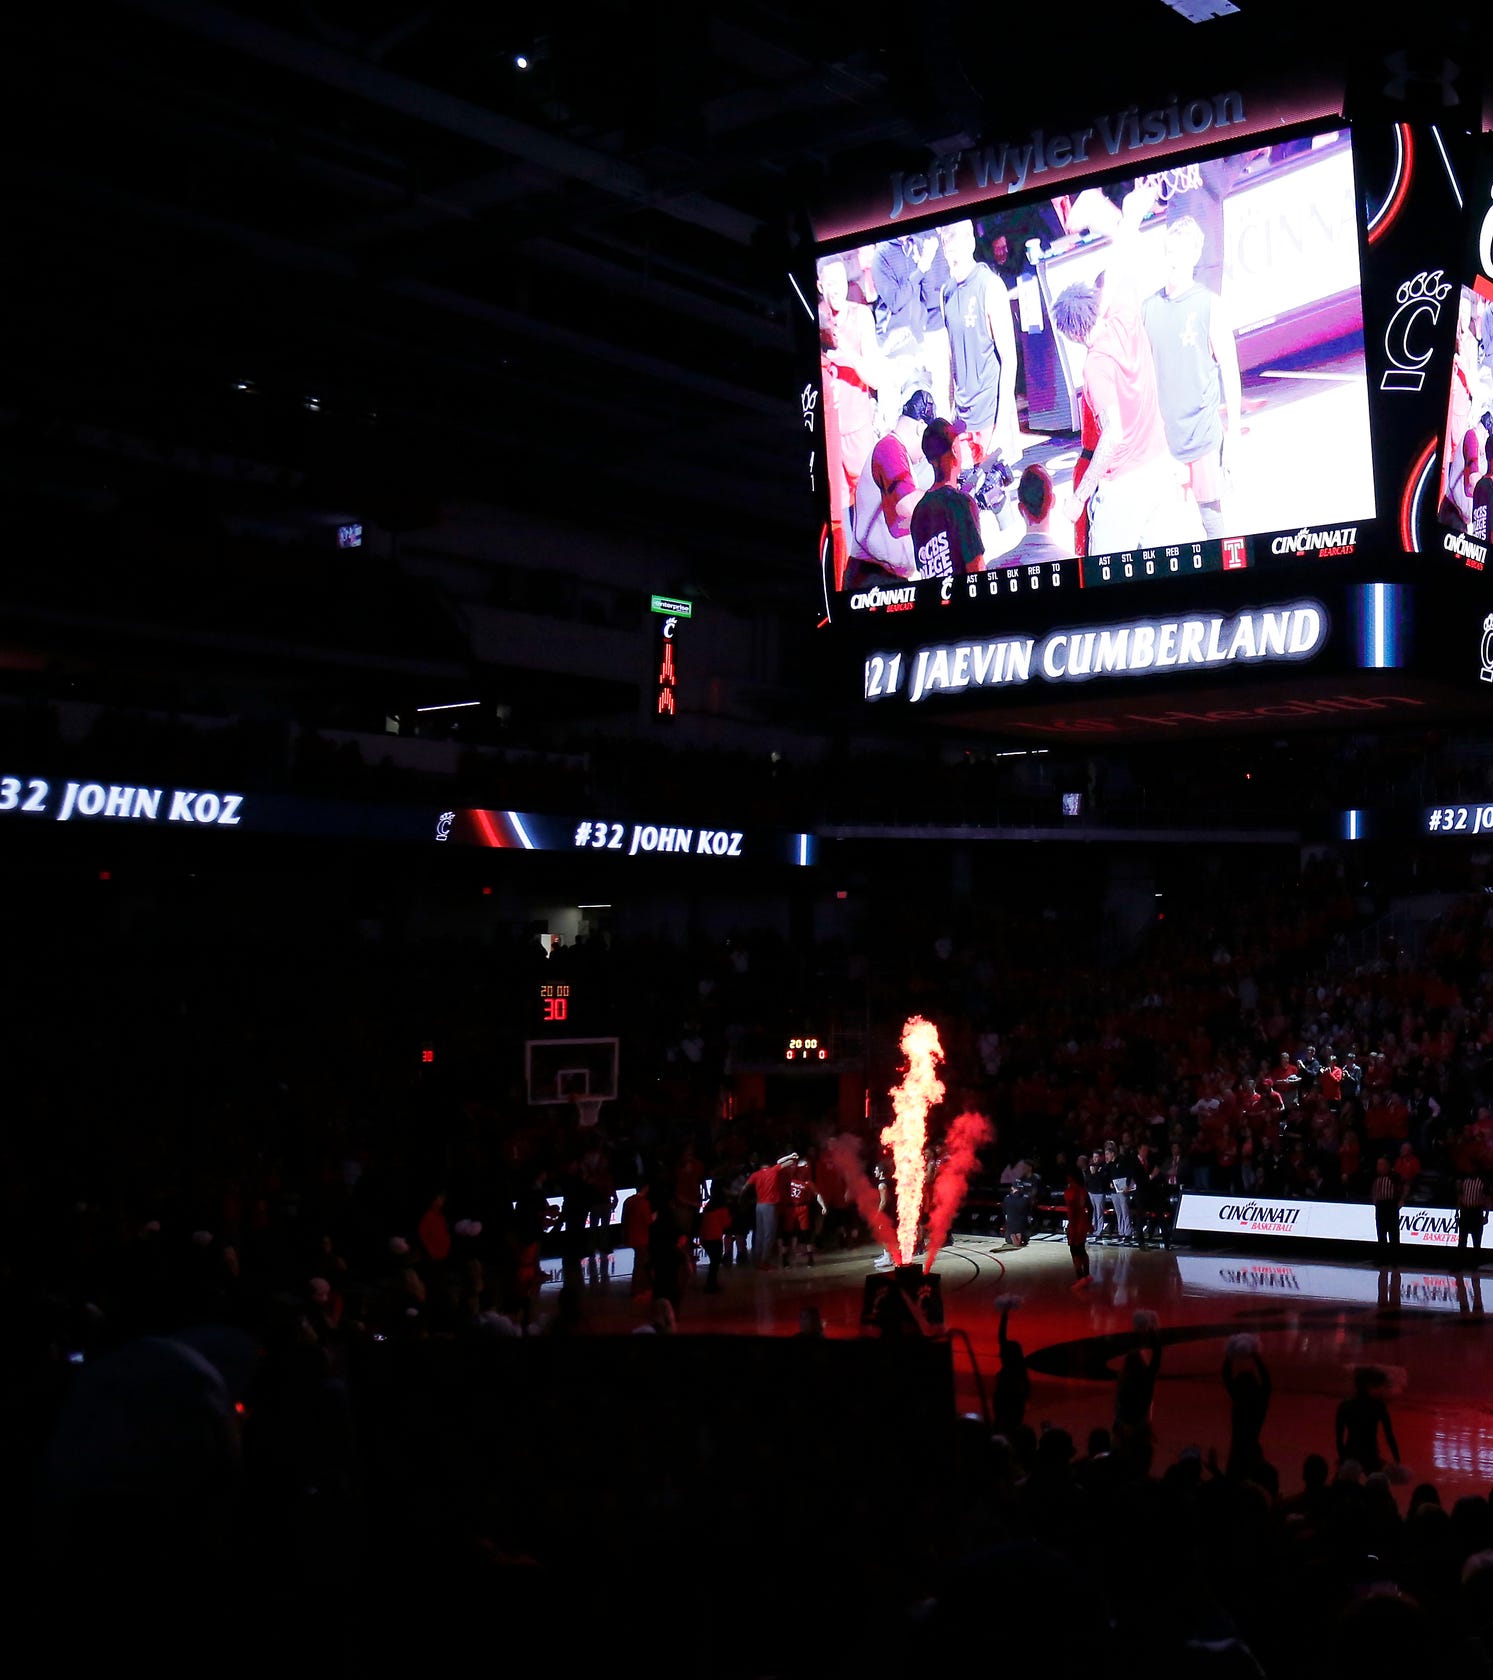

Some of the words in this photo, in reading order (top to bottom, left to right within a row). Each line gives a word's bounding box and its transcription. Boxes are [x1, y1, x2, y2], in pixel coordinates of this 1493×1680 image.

[888, 151, 961, 219] Jeff
[973, 128, 1094, 194] Wyler
[1096, 89, 1246, 155] Vision
[1224, 538, 1244, 567] T
[1271, 527, 1358, 554] CINCINNATI
[1318, 544, 1355, 557] BEARCATS
[1443, 532, 1488, 564] CINCINNATI
[1099, 555, 1110, 566] AST
[1121, 553, 1133, 563] STL
[1143, 550, 1155, 560] BLK
[1165, 547, 1179, 557] REB
[1191, 544, 1201, 554] TO
[967, 574, 978, 584] AST
[987, 572, 998, 581] STL
[1007, 569, 1018, 578] BLK
[1028, 566, 1041, 576] REB
[1052, 563, 1061, 572] TO
[1102, 566, 1111, 580] 0
[1124, 563, 1133, 577] 0
[1146, 561, 1155, 574] 0
[1170, 558, 1179, 571] 0
[1193, 555, 1202, 568] 0
[850, 584, 916, 610] CINCINNATI
[968, 585, 977, 597] 0
[989, 582, 998, 595] 0
[1009, 579, 1018, 592] 0
[1030, 576, 1039, 589] 0
[1052, 573, 1061, 586] 0
[909, 639, 1035, 702] JAEVIN
[1043, 608, 1320, 678] CUMBERLAND
[56, 783, 163, 821] JOHN
[168, 790, 244, 824] KOZ
[1428, 807, 1468, 831] #32
[574, 820, 624, 849] #32
[628, 824, 693, 855] JOHN
[697, 831, 743, 856] KOZ
[543, 998, 568, 1021] 30
[791, 1187, 802, 1199] 32
[1219, 1202, 1301, 1224] CINCINNATI
[1399, 1211, 1459, 1233] INCINNA
[1251, 1222, 1293, 1232] BASKETBALL
